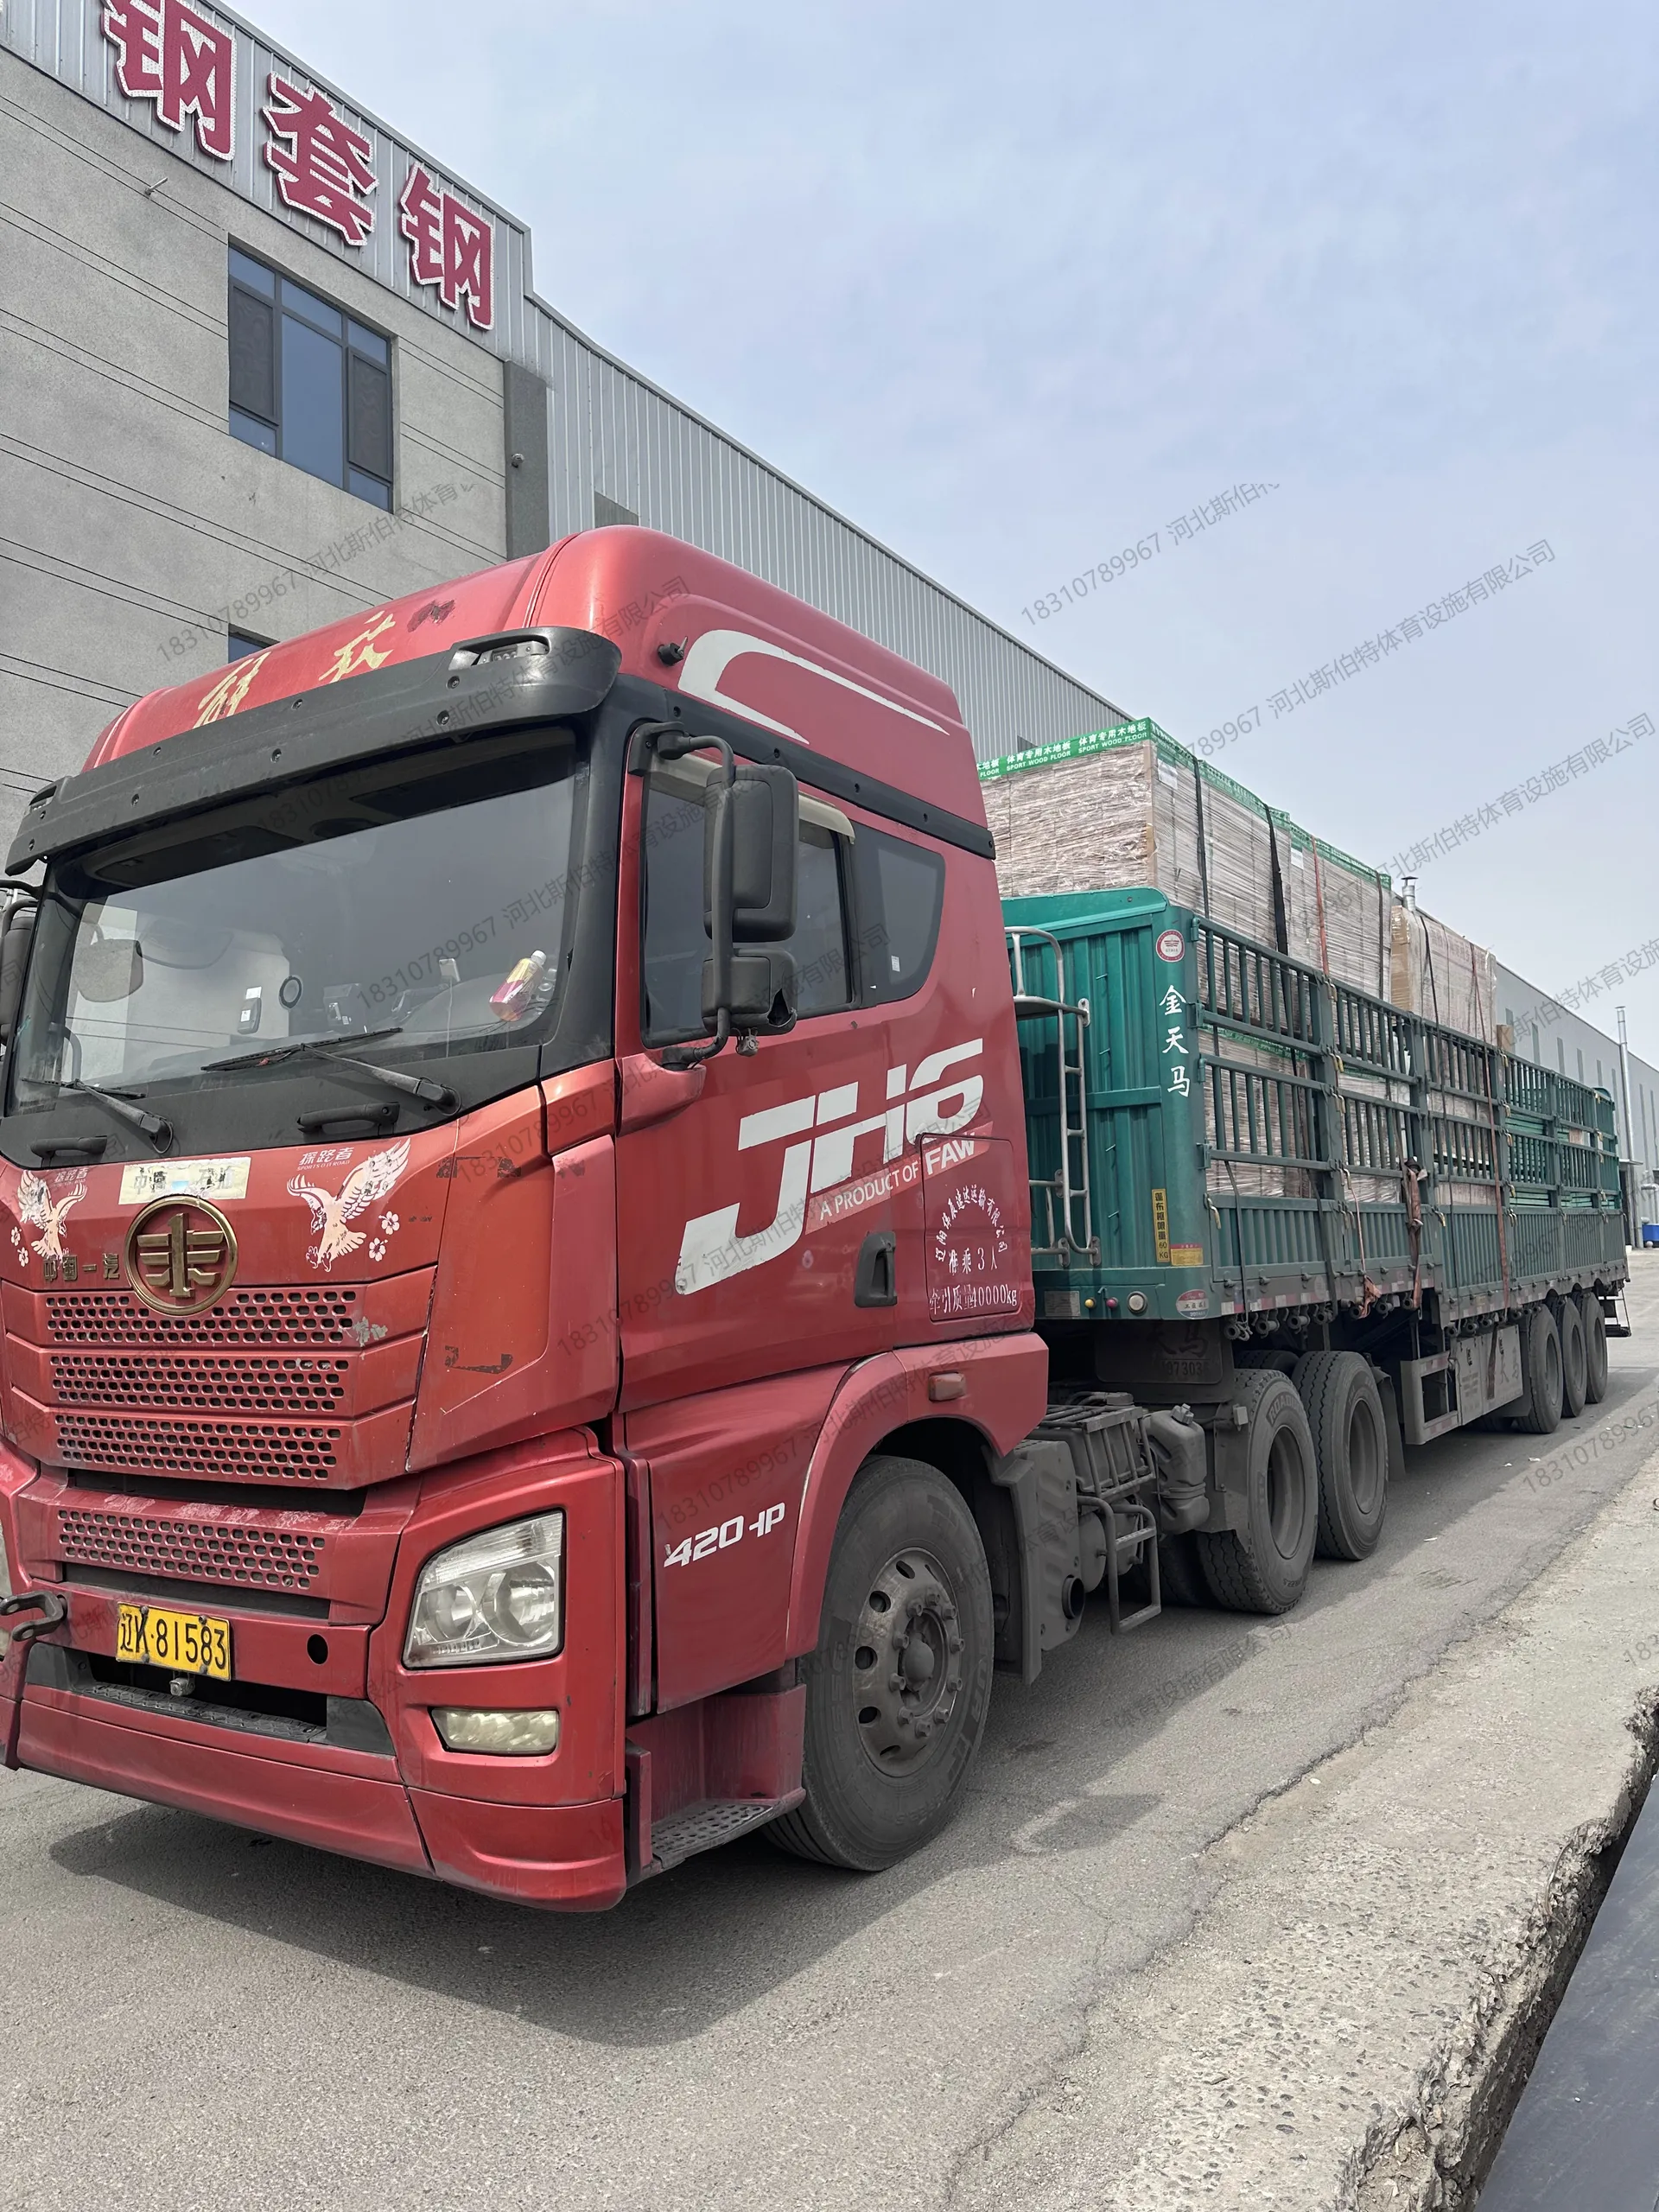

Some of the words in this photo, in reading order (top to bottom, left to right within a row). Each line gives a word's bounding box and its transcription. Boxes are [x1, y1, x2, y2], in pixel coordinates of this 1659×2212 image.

[1078, 721, 1147, 746] 体育专用木地板
[1078, 743, 1099, 753] SPORT
[1101, 737, 1122, 747] WOOD
[1124, 731, 1147, 741] FLOOR
[1006, 741, 1071, 765] 体育专用木地板
[1006, 761, 1027, 772] SPORT
[1028, 756, 1049, 767] WOOD
[1050, 750, 1071, 761] FLOOR
[1159, 984, 1192, 1098] 金天马
[298, 1147, 355, 1166] 探路者
[820, 1200, 832, 1221] A
[834, 1169, 899, 1211] PRODUCT
[902, 1161, 919, 1183] OF
[925, 1132, 976, 1176] FAW
